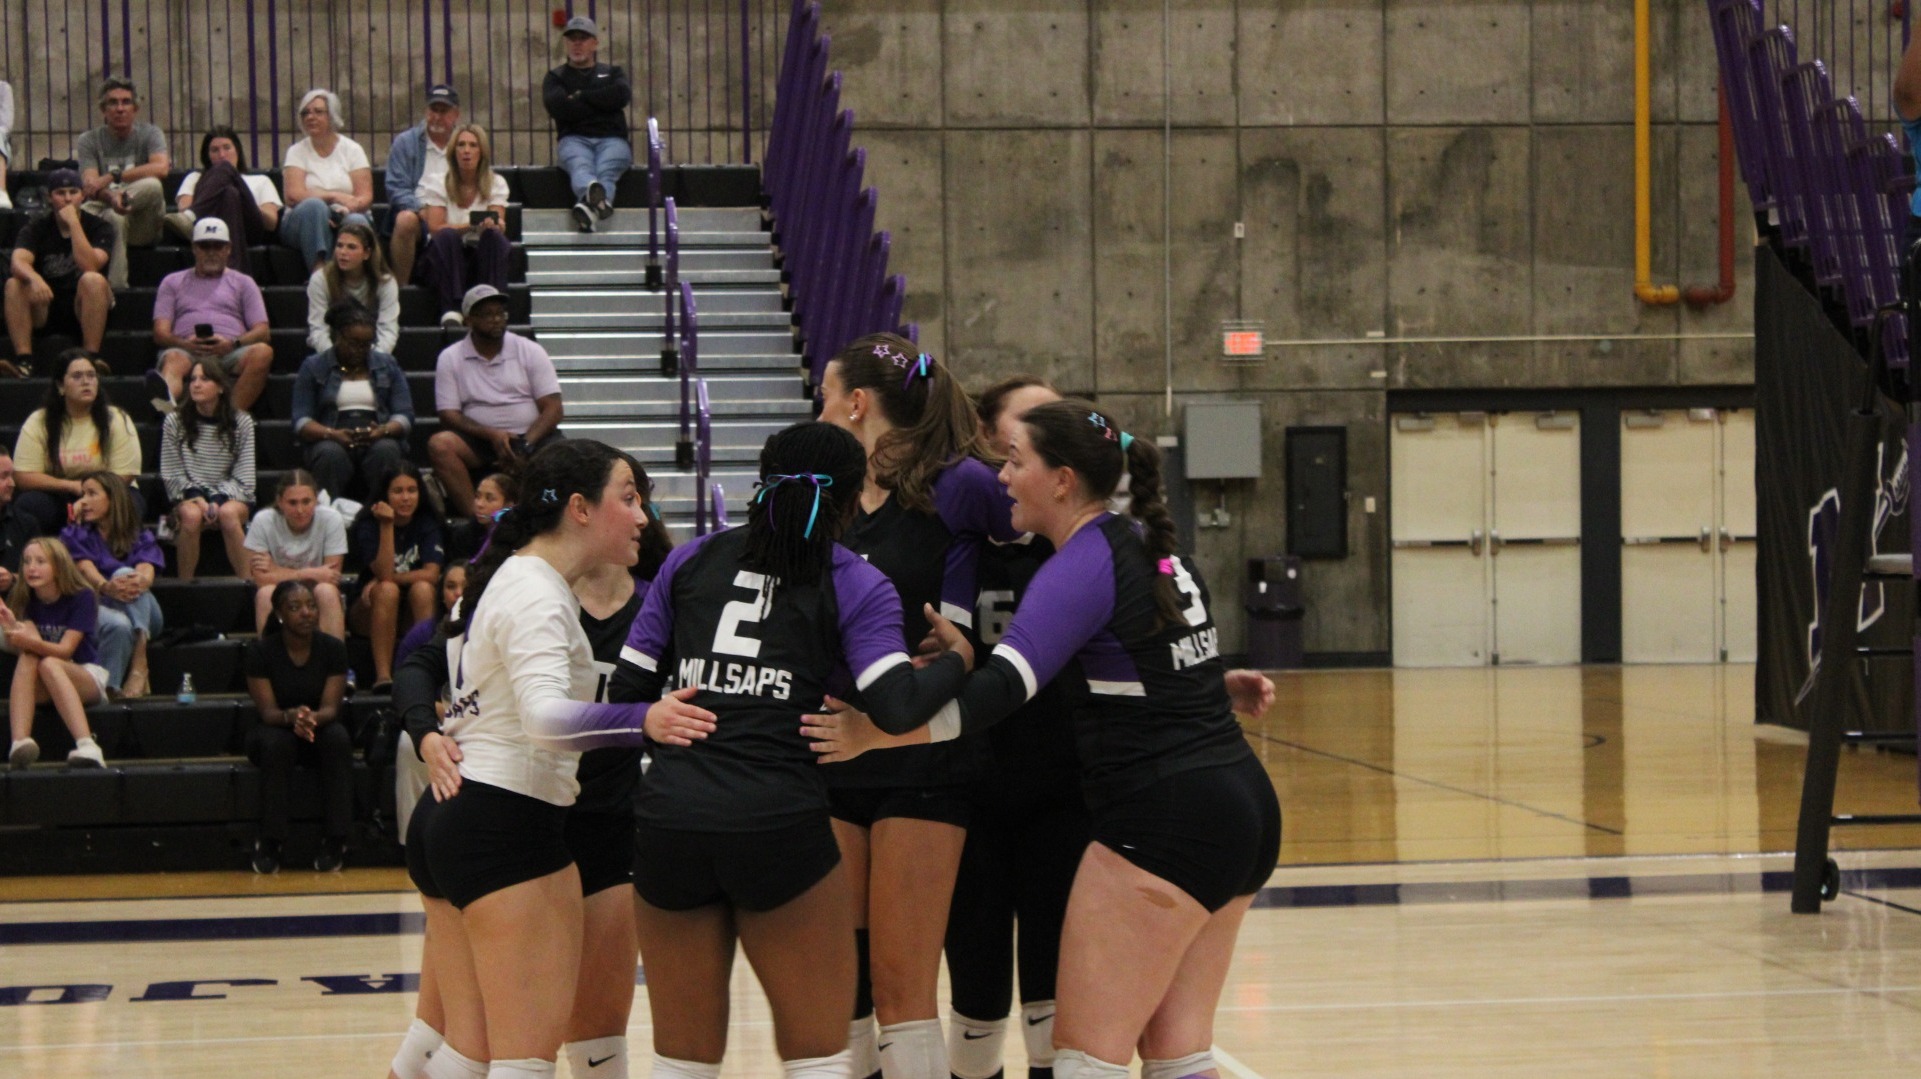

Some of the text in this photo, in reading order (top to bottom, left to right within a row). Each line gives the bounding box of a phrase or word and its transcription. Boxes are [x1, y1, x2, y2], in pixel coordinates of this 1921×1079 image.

[711, 569, 781, 658] 2
[977, 588, 1016, 645] 6
[678, 657, 793, 700] MILLSAPS
